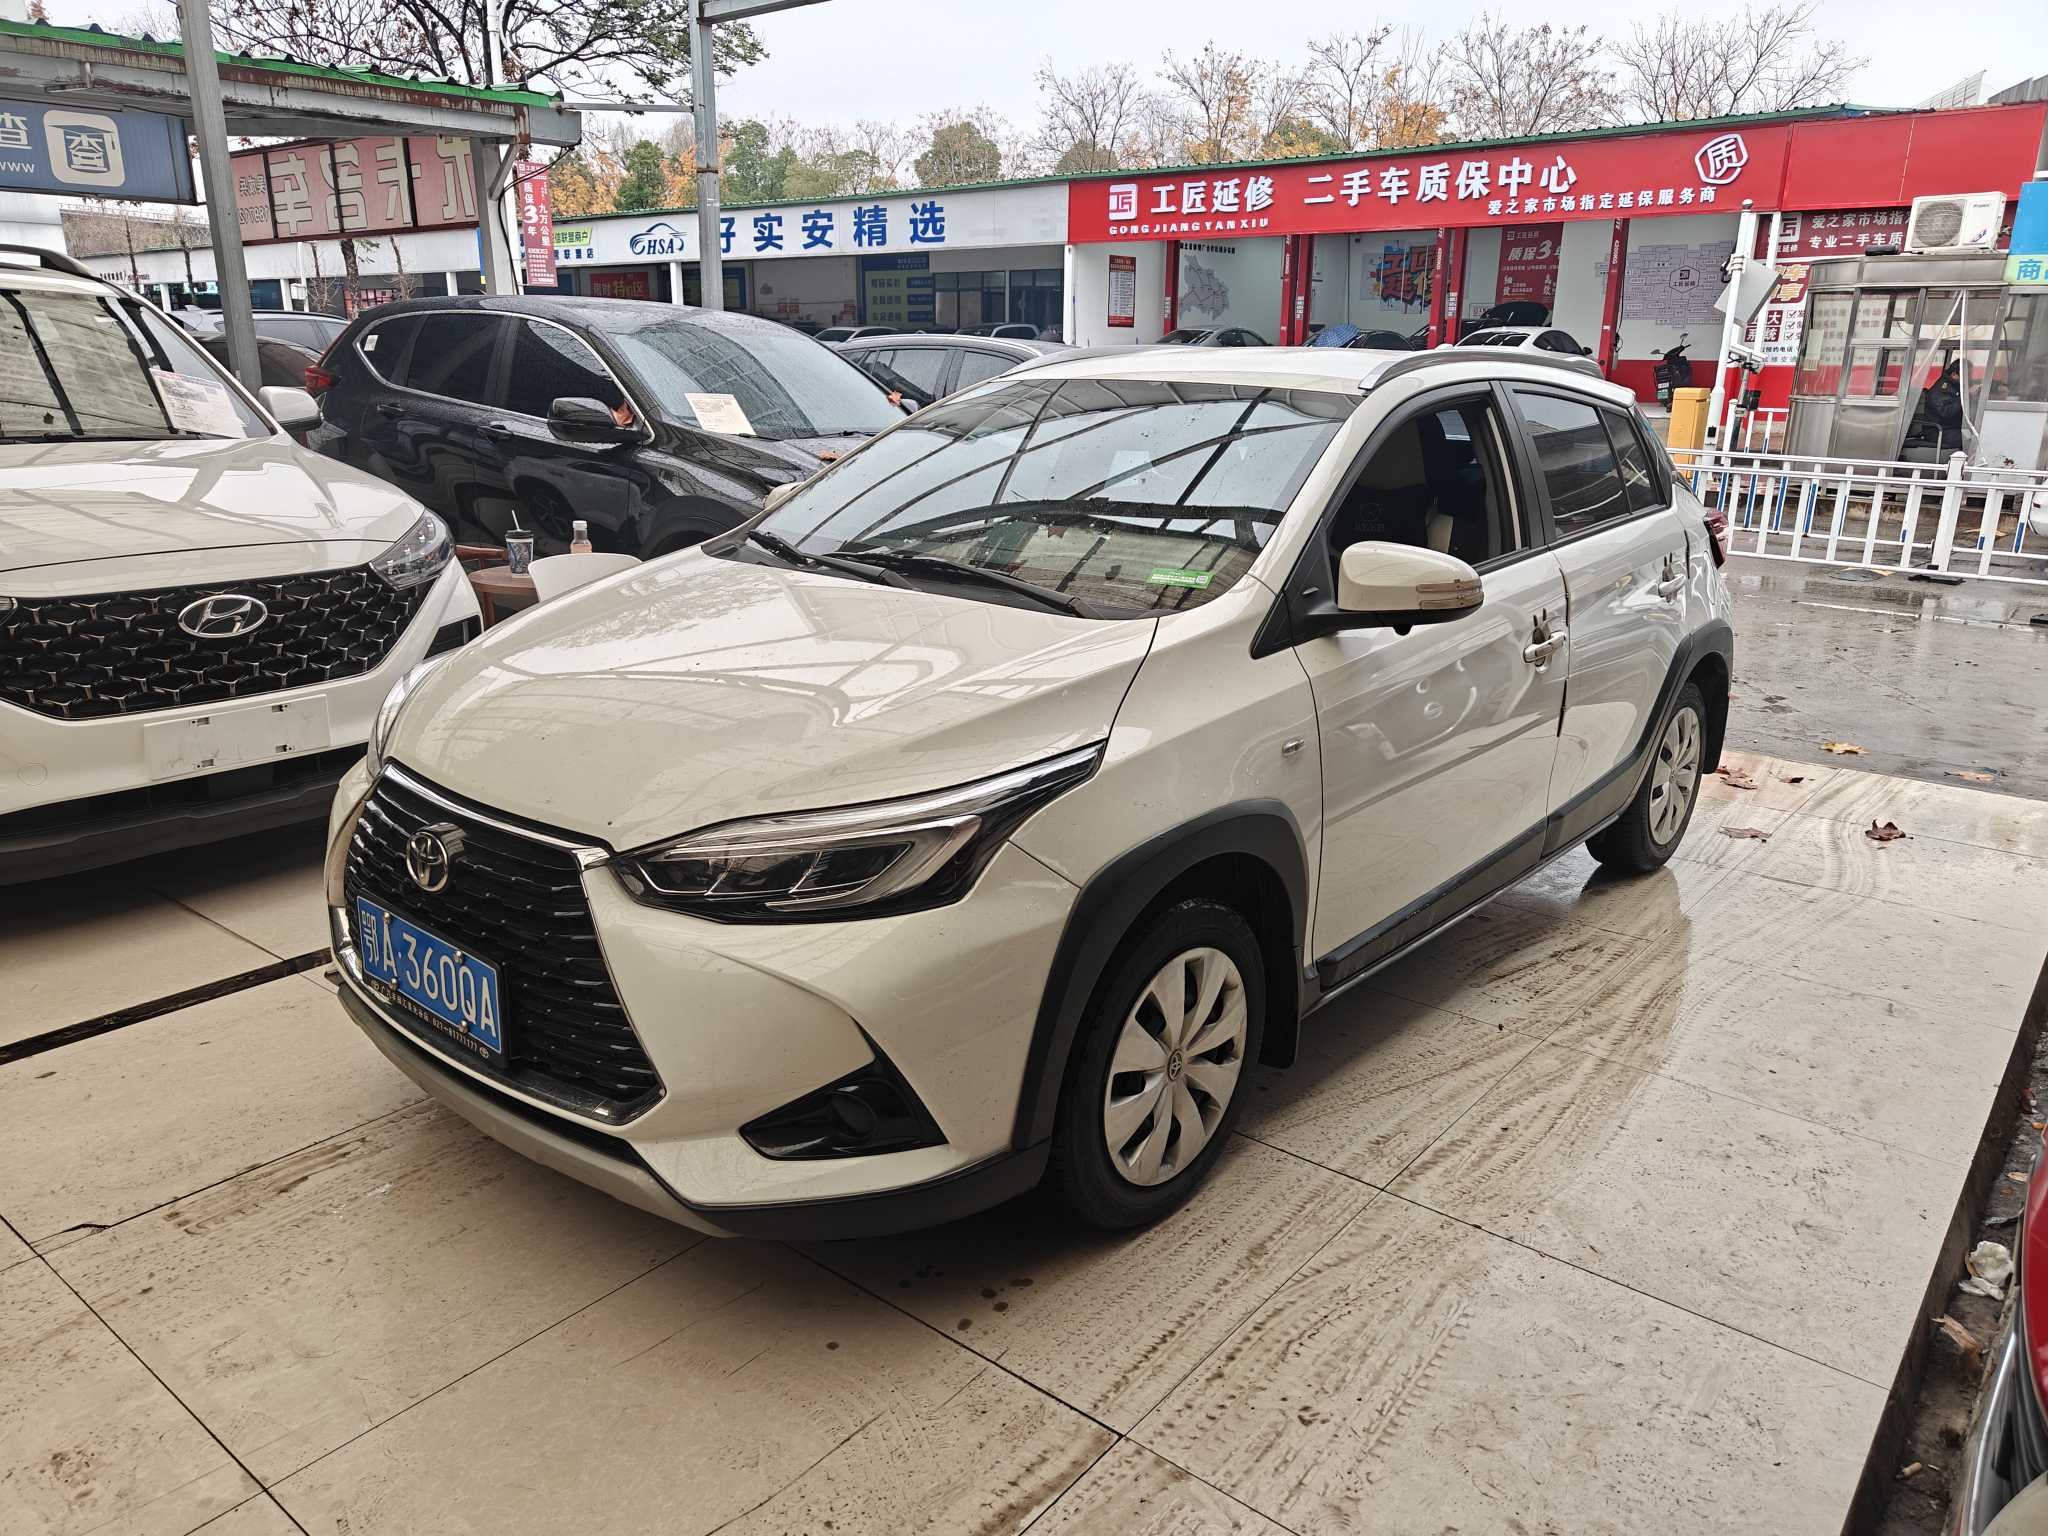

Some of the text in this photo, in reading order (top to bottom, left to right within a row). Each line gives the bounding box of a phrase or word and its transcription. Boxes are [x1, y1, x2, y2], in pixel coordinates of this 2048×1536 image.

[1304, 155, 1577, 207] 二手车质保中心
[1151, 176, 1275, 215] 工匠延修
[1488, 186, 1718, 215] 爱之家市场指定延保服务商
[1109, 217, 1269, 235] GONG JIANG YAN XIU
[647, 240, 675, 255] HSA
[2017, 259, 2048, 281] 商
